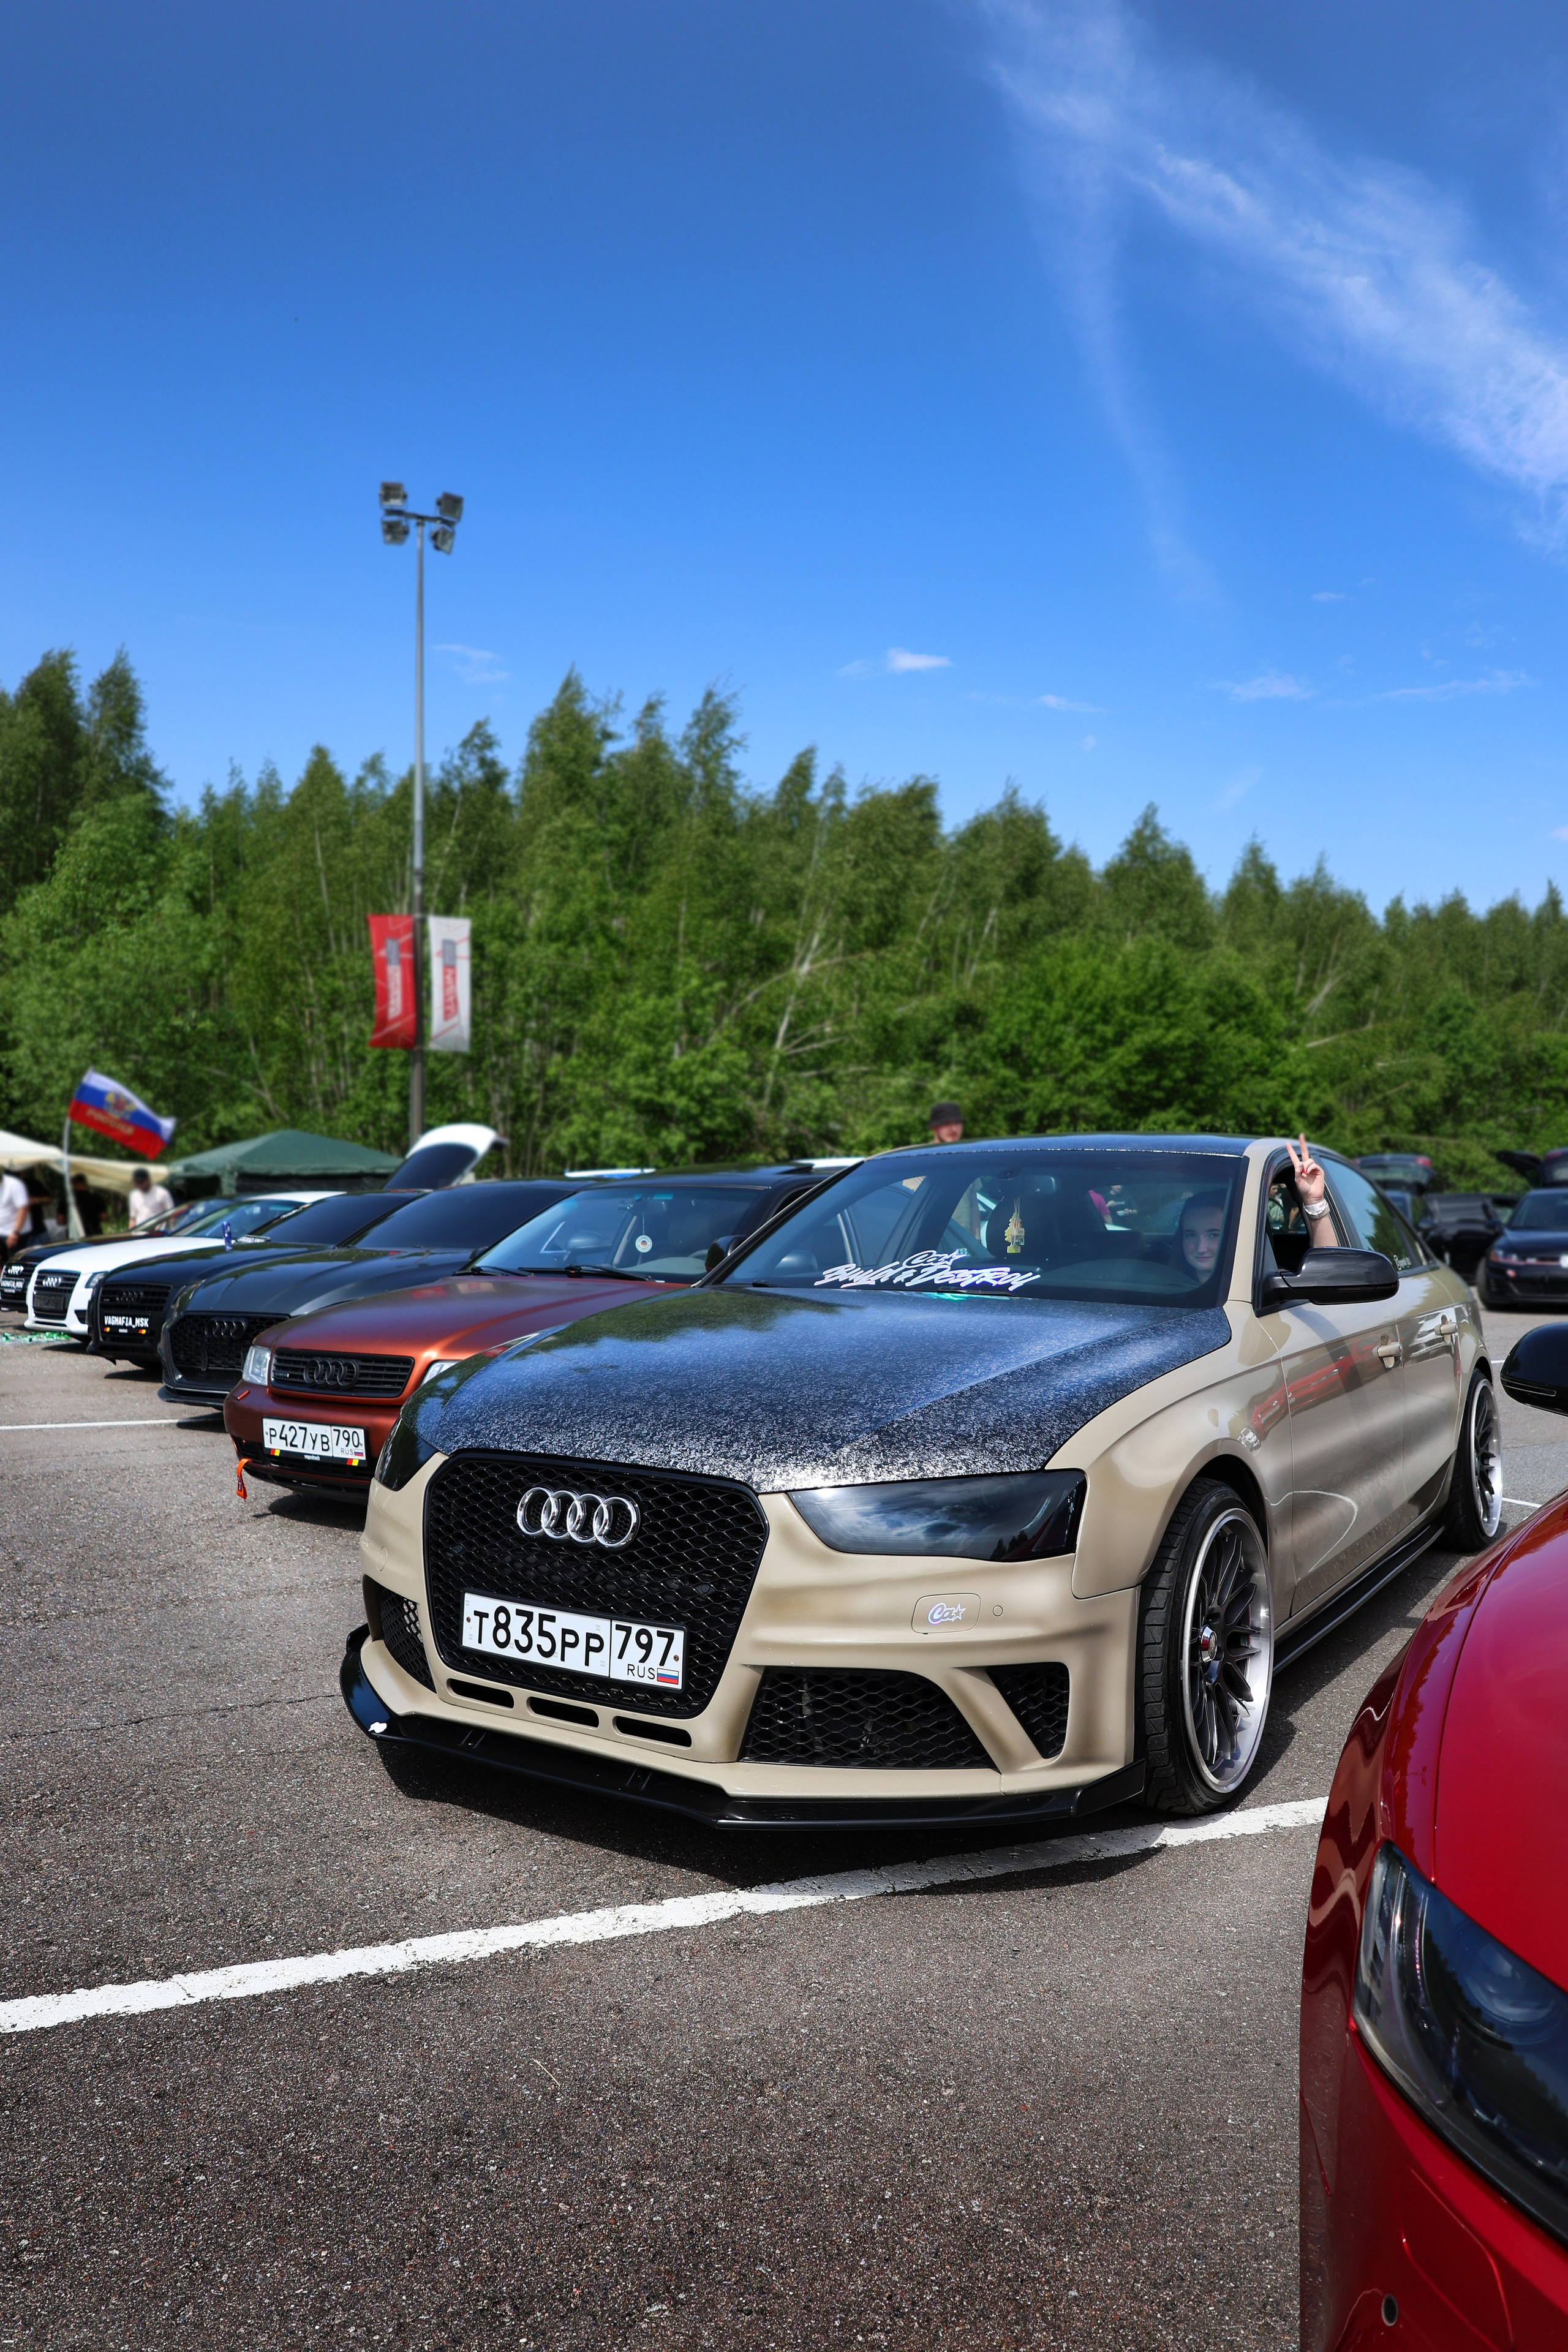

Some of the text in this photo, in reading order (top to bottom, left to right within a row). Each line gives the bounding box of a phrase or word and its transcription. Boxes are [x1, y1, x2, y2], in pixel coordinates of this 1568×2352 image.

[333, 1428, 360, 1448] 790
[615, 1624, 675, 1667] 797
[627, 1664, 655, 1680] RUS
